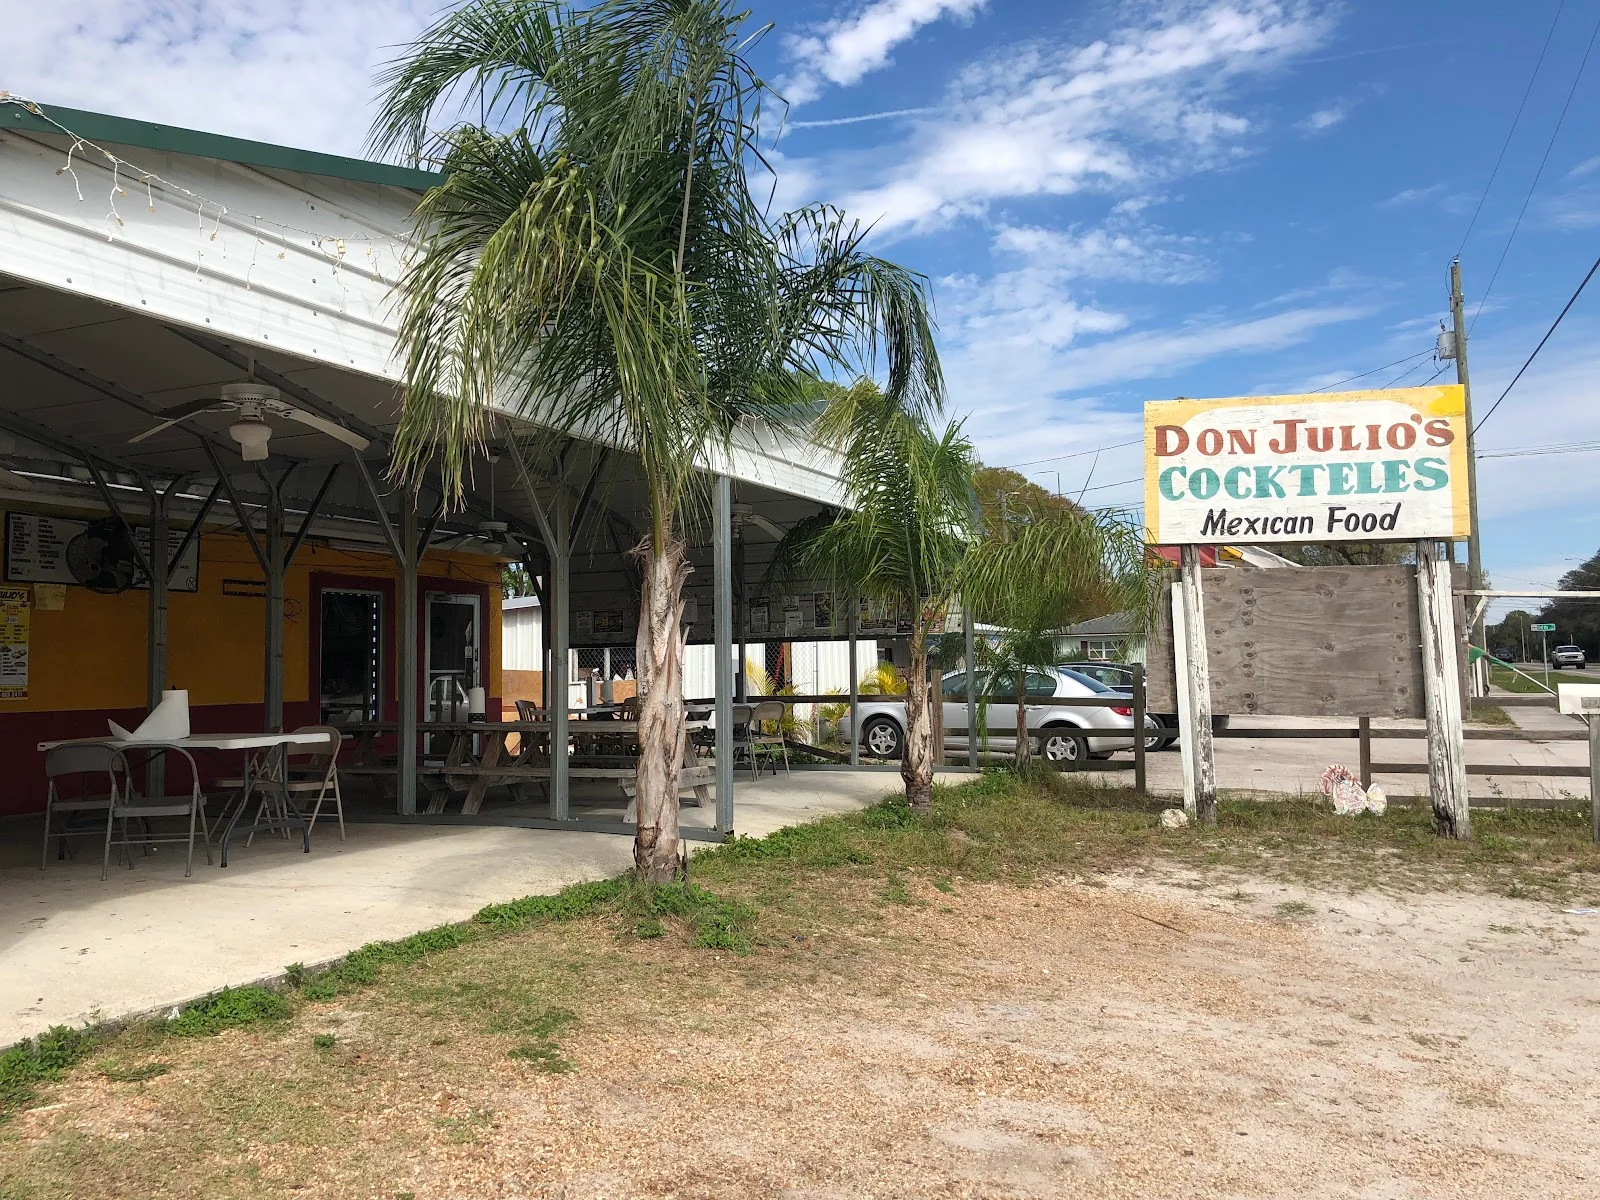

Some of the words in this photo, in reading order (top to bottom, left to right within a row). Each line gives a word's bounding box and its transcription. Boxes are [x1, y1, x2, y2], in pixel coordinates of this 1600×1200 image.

[1153, 424, 1258, 457] DON
[1268, 413, 1455, 454] JULIO'S
[1158, 457, 1449, 501] COCKTELES
[1200, 508, 1314, 536] Mexican
[1326, 502, 1402, 533] Food
[0, 591, 25, 600] ULIO'S
